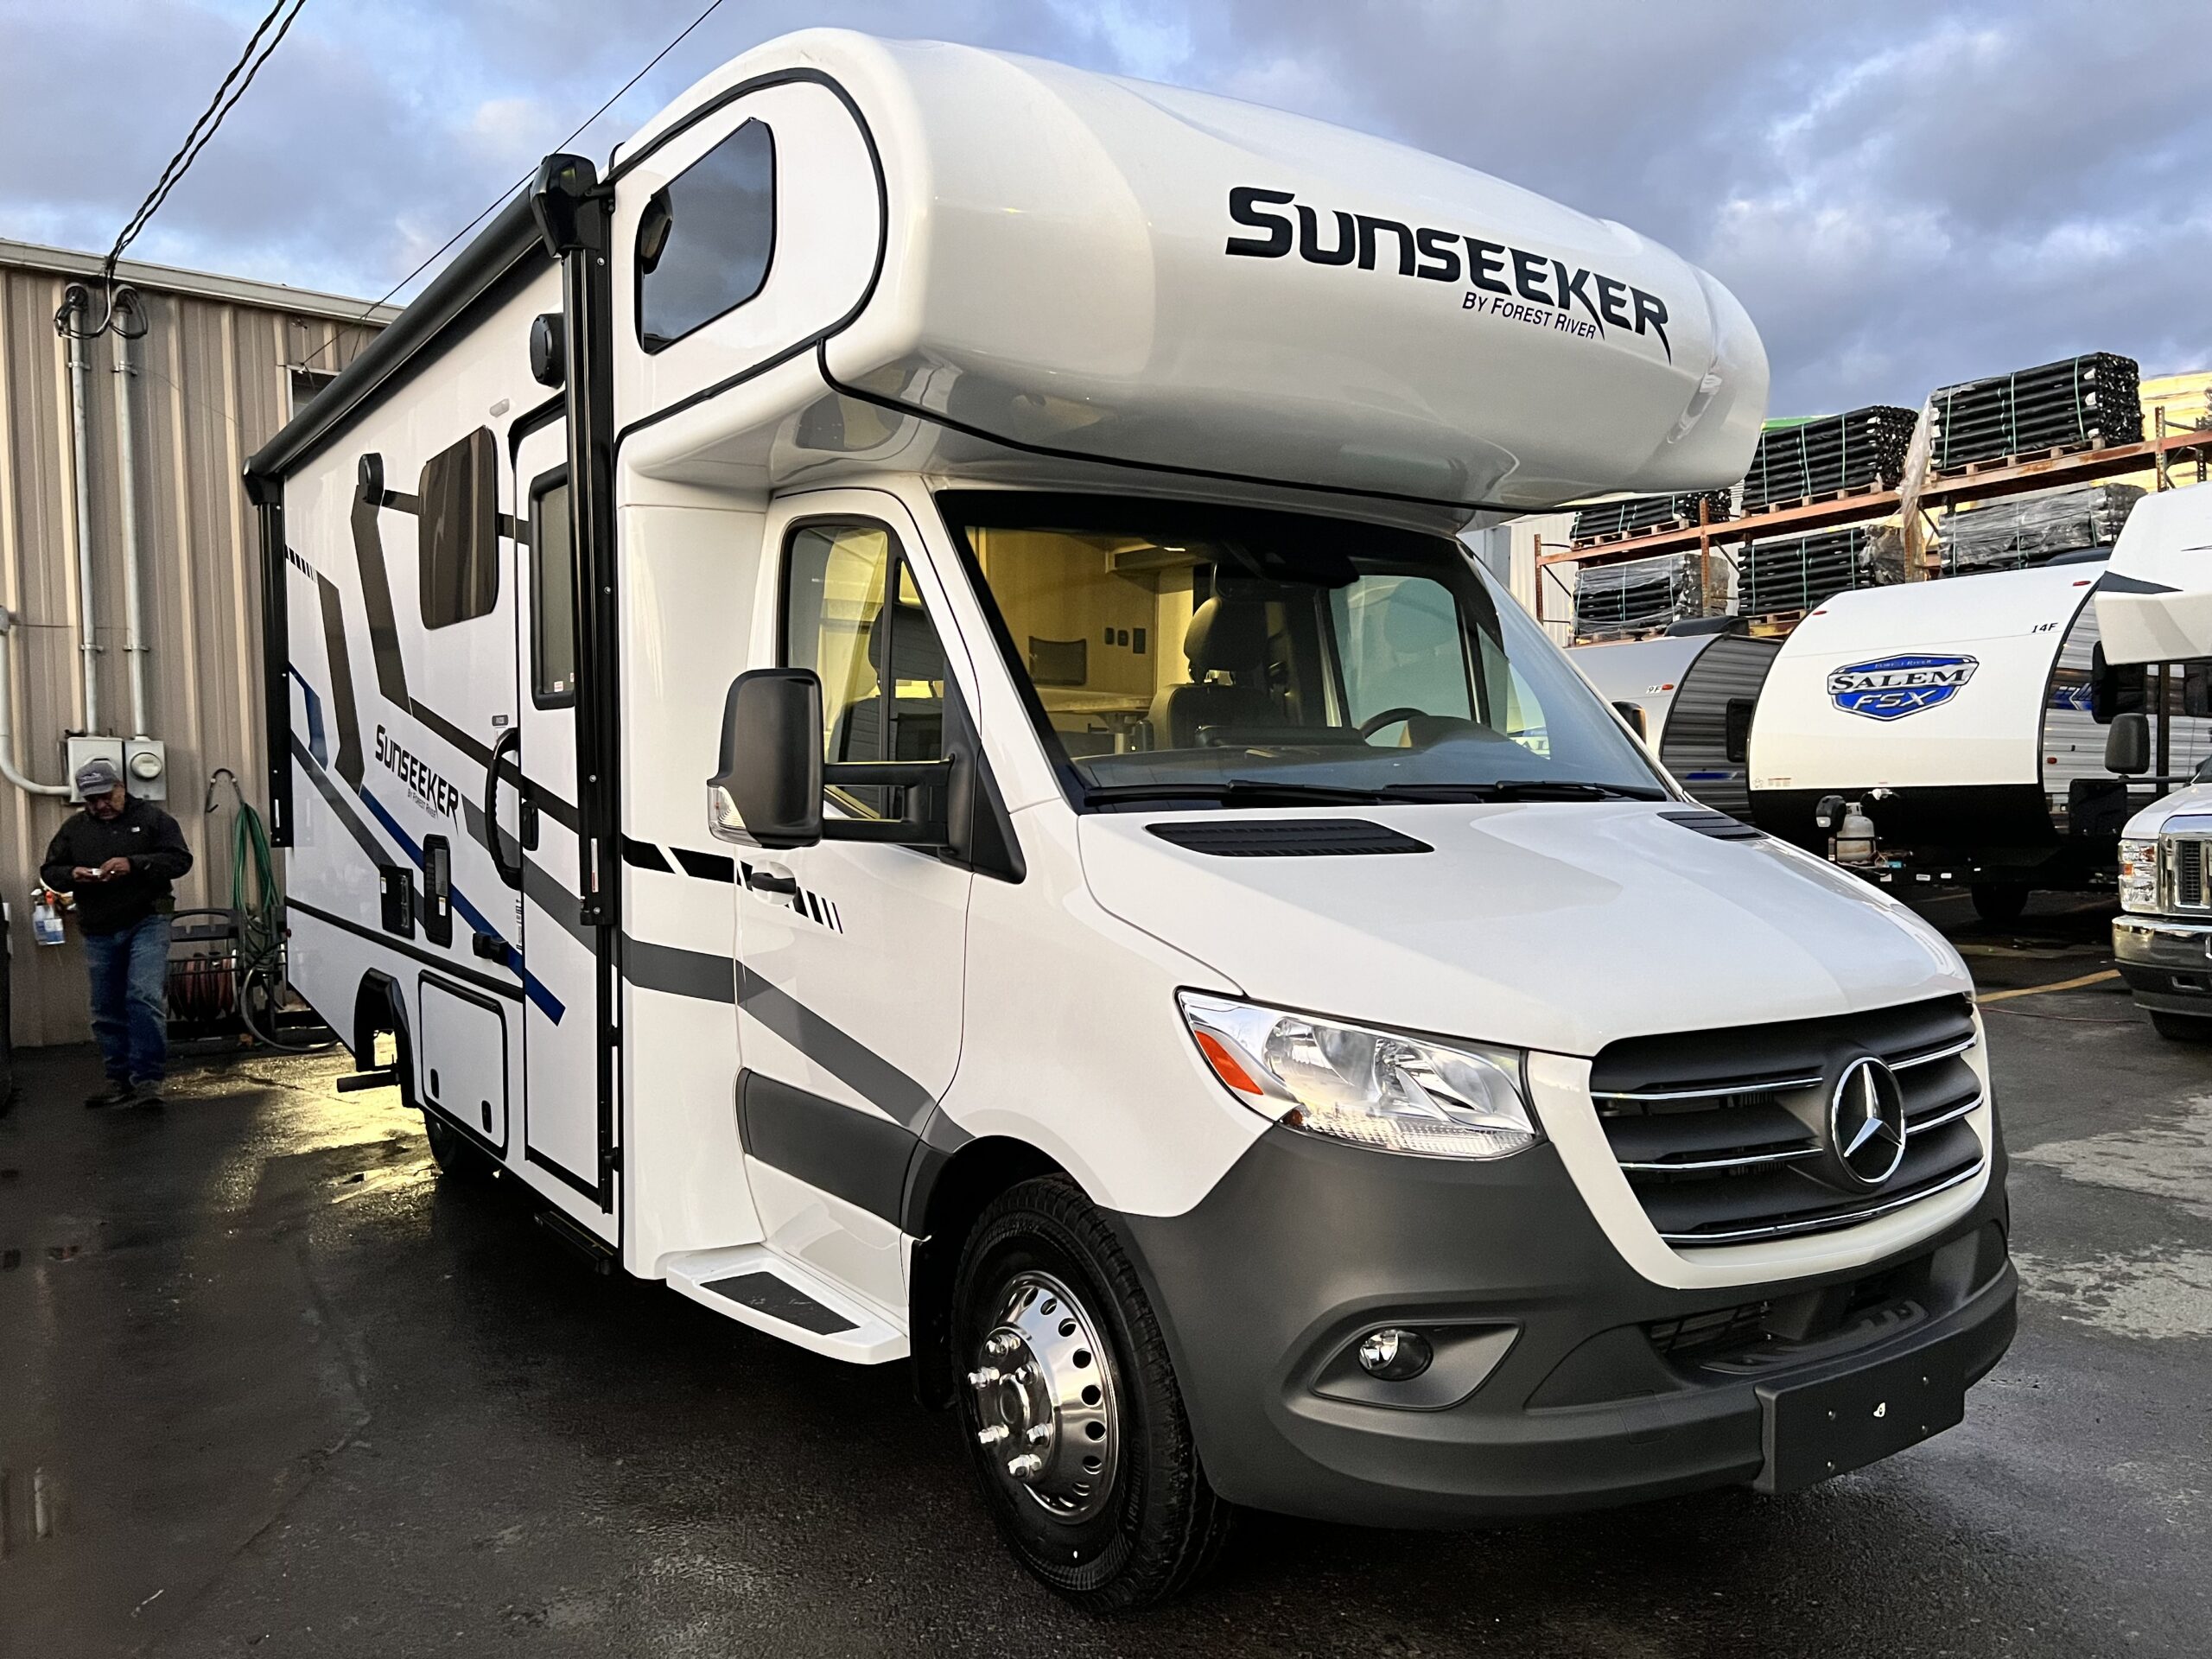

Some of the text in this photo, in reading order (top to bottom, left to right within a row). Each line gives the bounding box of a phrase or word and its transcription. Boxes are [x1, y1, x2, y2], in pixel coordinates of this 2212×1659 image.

[1224, 186, 1671, 366] SUNSEEKER
[1462, 291, 1596, 340] BY FOREST RIVER
[2031, 622, 2058, 633] 14F
[1832, 669, 1968, 690] SALEM
[1853, 690, 1937, 710] FSX
[375, 724, 459, 836] SUNSEEKER
